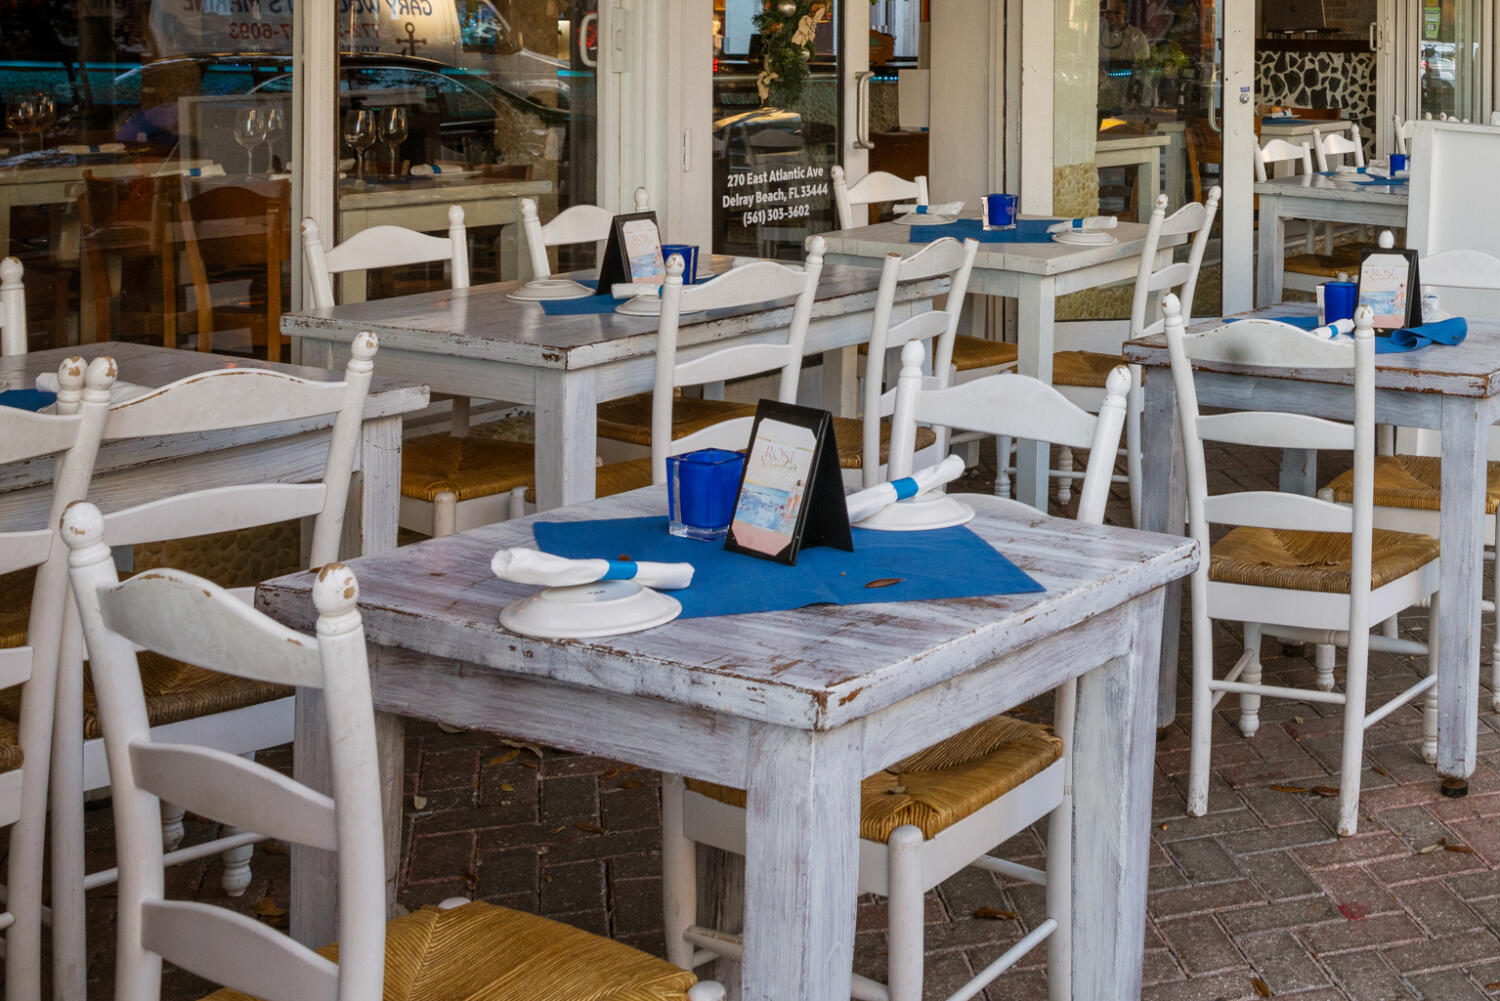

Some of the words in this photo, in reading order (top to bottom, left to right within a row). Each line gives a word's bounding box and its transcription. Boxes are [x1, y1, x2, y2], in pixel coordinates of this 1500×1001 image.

[727, 173, 746, 188] 270
[746, 171, 768, 185] East
[769, 166, 806, 183] Atlantic
[806, 166, 824, 178] Ave
[722, 194, 756, 209] Delray
[755, 188, 787, 203] Beach,
[788, 186, 799, 199] FL
[800, 182, 829, 198] 33444
[743, 210, 766, 228] (561)
[767, 204, 810, 222] 303-3602
